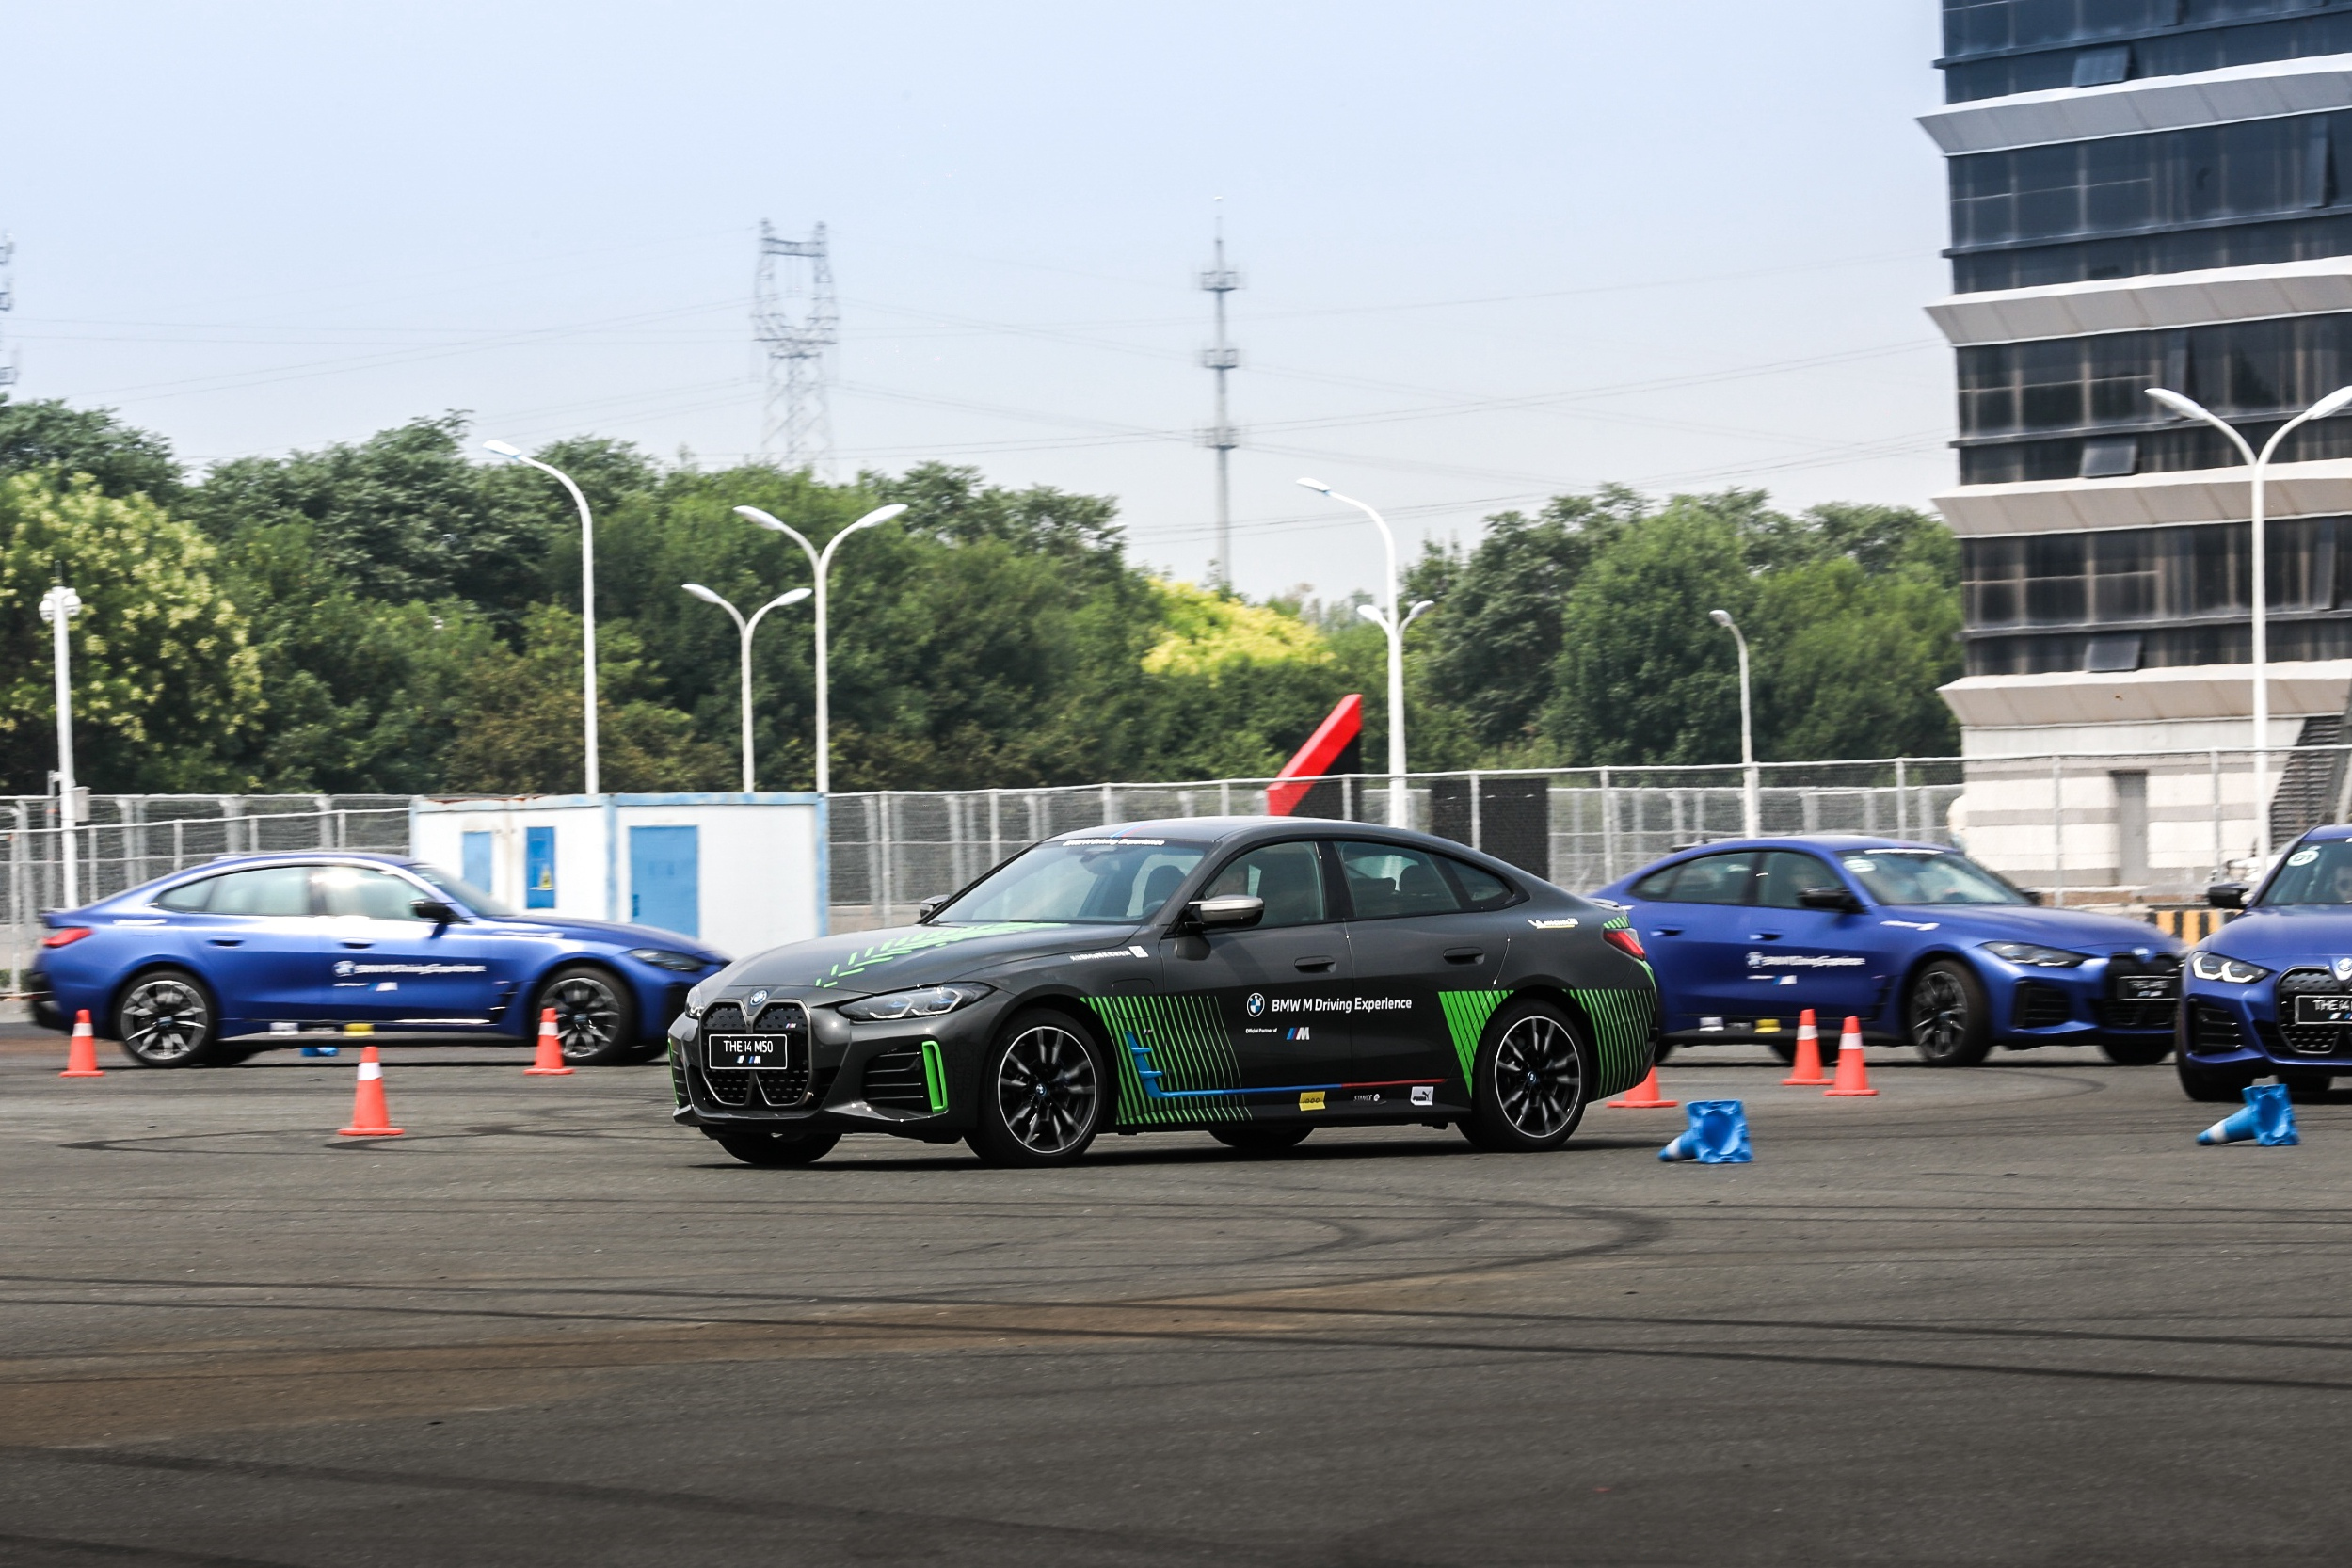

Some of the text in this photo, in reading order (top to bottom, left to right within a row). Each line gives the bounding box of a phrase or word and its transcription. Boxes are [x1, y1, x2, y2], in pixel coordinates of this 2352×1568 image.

[1272, 999, 1302, 1013] BMW
[1303, 998, 1313, 1012] M
[1314, 998, 1352, 1014] Driving
[1353, 996, 1413, 1014] Experience
[2312, 1000, 2339, 1012] THE
[723, 1040, 743, 1053] THE
[754, 1040, 774, 1053] M50
